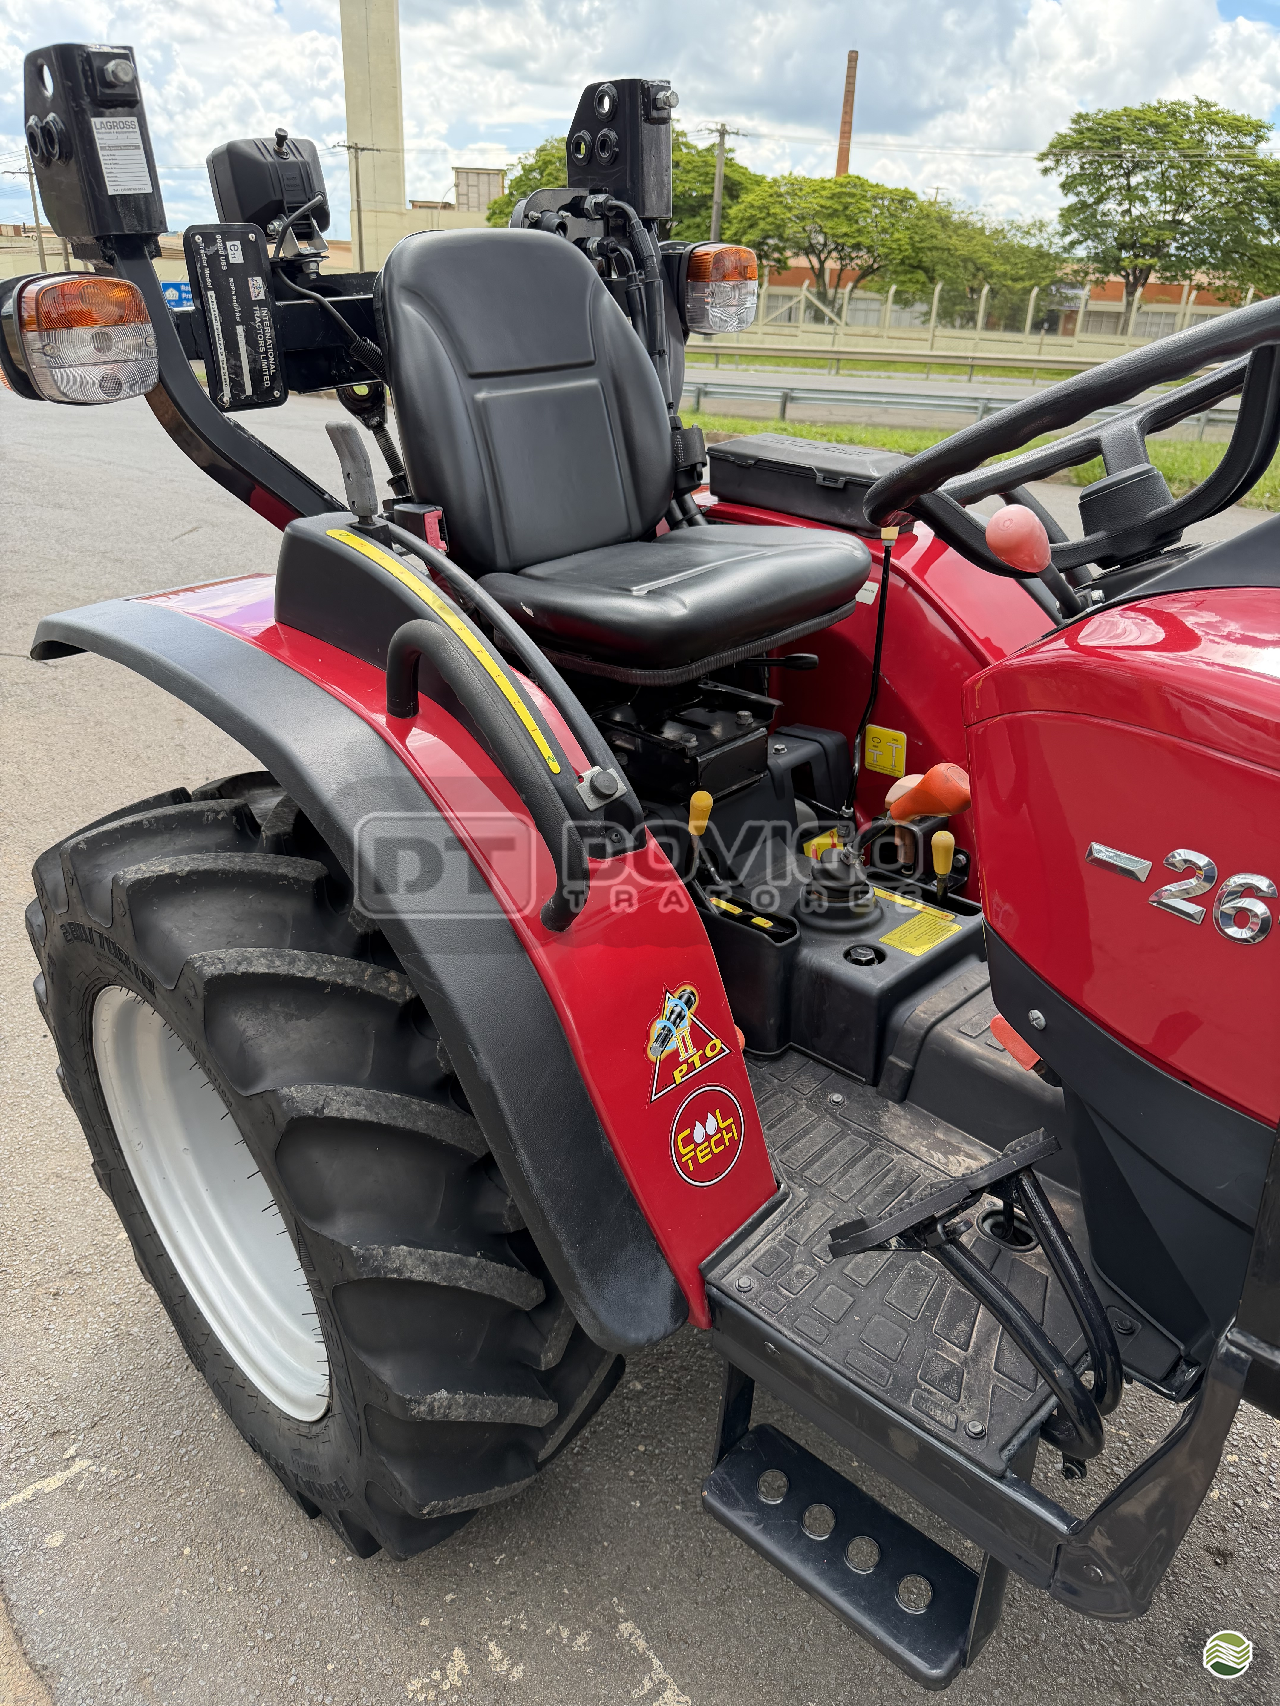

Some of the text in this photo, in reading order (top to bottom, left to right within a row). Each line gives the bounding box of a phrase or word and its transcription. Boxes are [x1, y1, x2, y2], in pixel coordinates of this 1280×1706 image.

[94, 121, 136, 130] LAGROSS
[252, 304, 271, 387] TRACTORS LIMITED
[259, 306, 277, 375] INTERNATIONAL
[1148, 849, 1279, 944] 26
[672, 1038, 722, 1085] PTO
[681, 1123, 739, 1172] TECH
